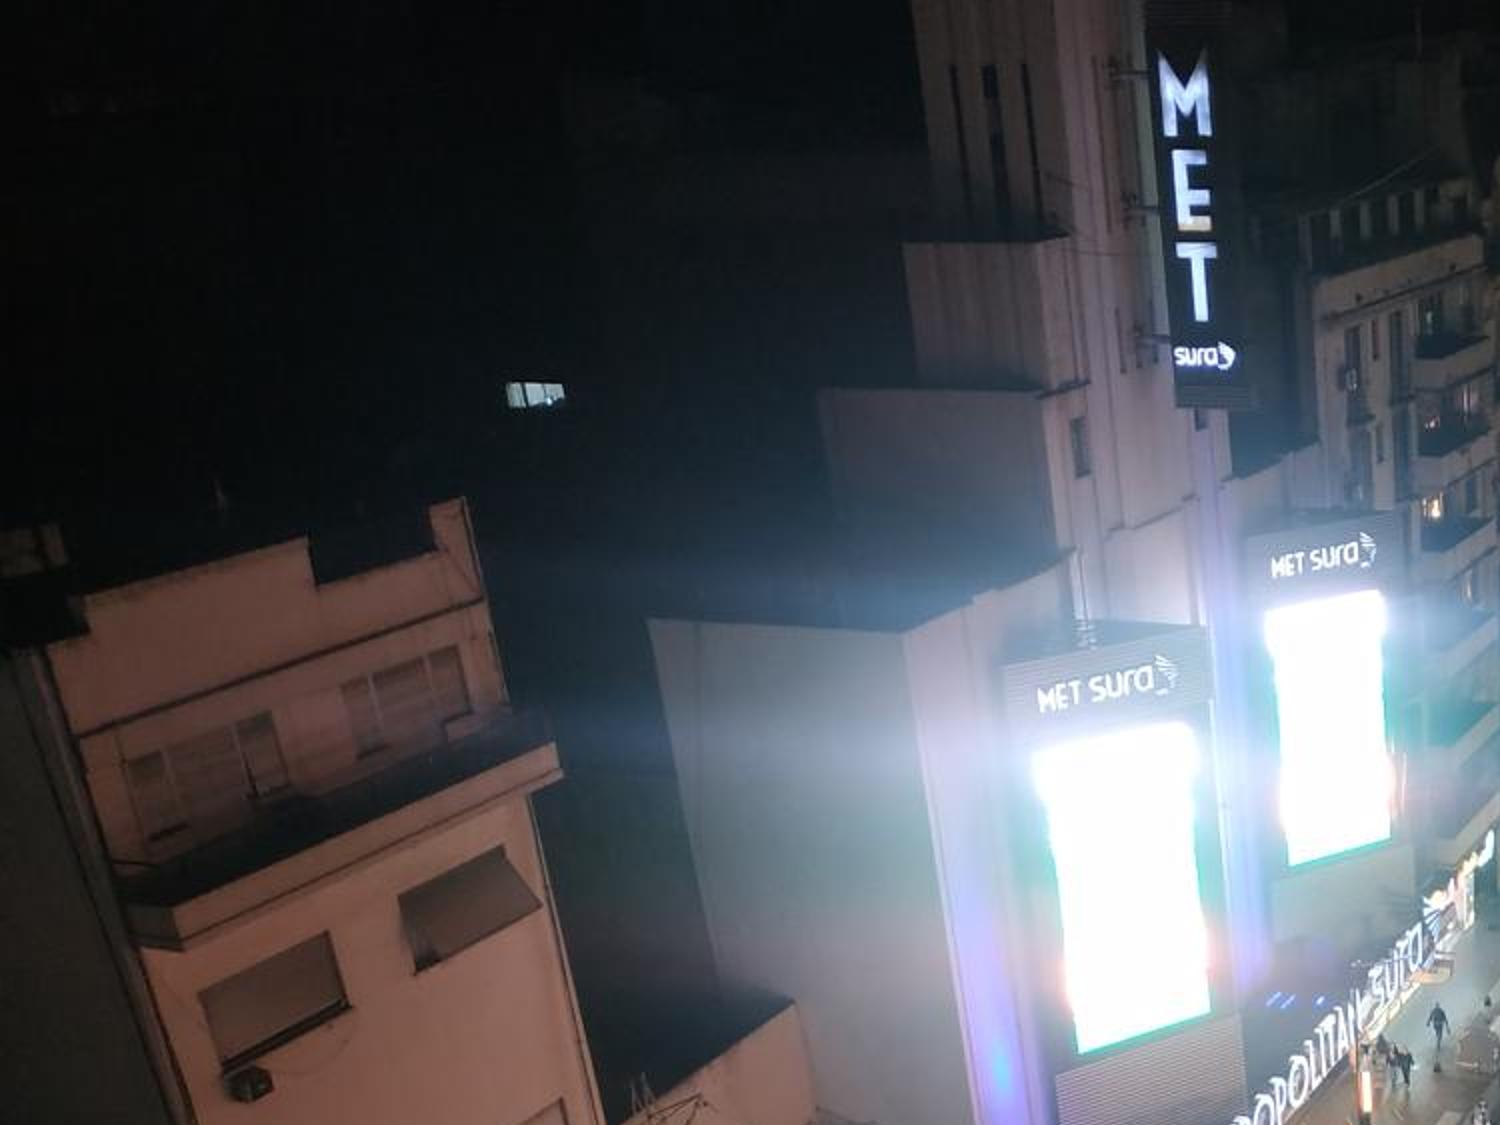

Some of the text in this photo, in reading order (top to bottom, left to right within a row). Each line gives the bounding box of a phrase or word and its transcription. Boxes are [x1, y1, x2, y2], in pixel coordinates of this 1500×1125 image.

[1158, 48, 1218, 323] MET
[1174, 344, 1219, 367] sura
[1270, 540, 1359, 578] MET sura
[1037, 668, 1156, 713] MET sura
